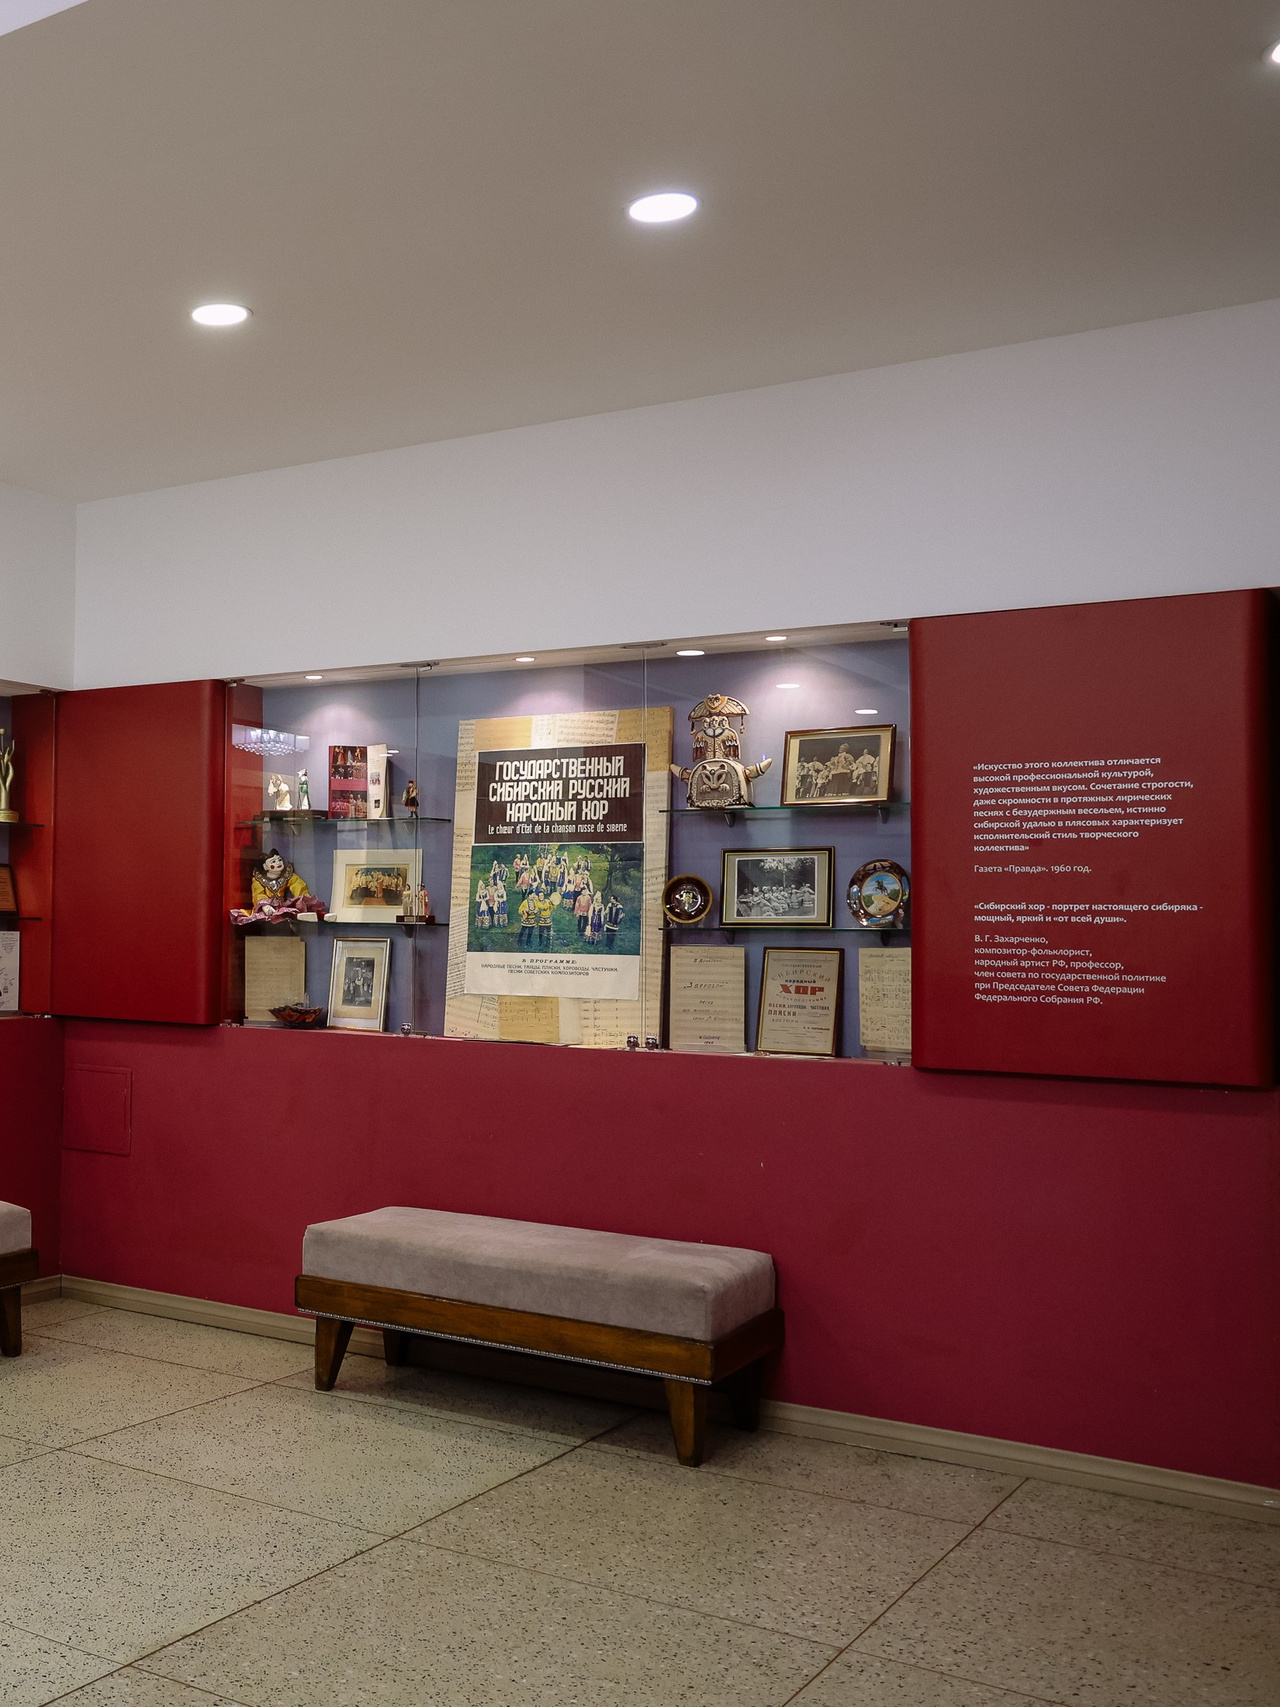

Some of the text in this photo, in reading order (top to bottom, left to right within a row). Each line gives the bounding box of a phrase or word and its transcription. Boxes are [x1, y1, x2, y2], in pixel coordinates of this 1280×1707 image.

[495, 756, 625, 781] ГОСУДАРСТВЕННЫЙ
[972, 762, 1023, 771] «Искусство
[1051, 759, 1105, 767] коллектива
[1106, 757, 1161, 765] отличается
[973, 768, 1154, 782] высокой профессиональной культурой,
[489, 778, 630, 802] СИБИРСКИЙ РУССКИЙ
[973, 780, 1193, 795] художественным вкусом. Сочетание строгости,
[972, 798, 996, 807] даже
[997, 797, 1051, 806] скромности
[1060, 795, 1114, 805] протяжных
[1115, 794, 1172, 803] лирических
[506, 800, 609, 822] НАРОДНЫЙ ХОР
[1011, 807, 1076, 817] безудержным
[535, 824, 542, 833] de
[544, 823, 549, 833] la
[551, 823, 575, 833] chanson
[578, 824, 594, 832] russe
[597, 822, 604, 832] de
[973, 819, 1020, 830] сибирской
[1021, 820, 1056, 829] удалью
[1111, 818, 1183, 827] характеризует
[973, 830, 1050, 840] исполнительский
[1079, 831, 1139, 840] творческого
[974, 864, 1092, 874] Газета «Правда». 1960 год.
[973, 901, 1026, 911] «Сибирский
[1027, 903, 1045, 912] хор
[1051, 903, 1090, 912] портрет
[1091, 904, 1149, 912] настоящего
[1150, 902, 1198, 912] сибиряка
[973, 913, 1014, 923] мощный,
[1016, 913, 1044, 924] яркий
[1070, 914, 1092, 922] всей
[1093, 916, 1126, 924] души».
[974, 934, 1048, 944] В. Г. Захарченко,
[974, 946, 1092, 957] композитор-фольклорист,
[974, 958, 1124, 970] народный артист РФ, профессор,
[1040, 972, 1120, 981] государственной
[1121, 974, 1166, 982] политике
[780, 984, 824, 995] ХОР
[974, 981, 1144, 995] при Председателе Совета Федерации
[974, 992, 1103, 1005] Федерального Собрания РФ.
